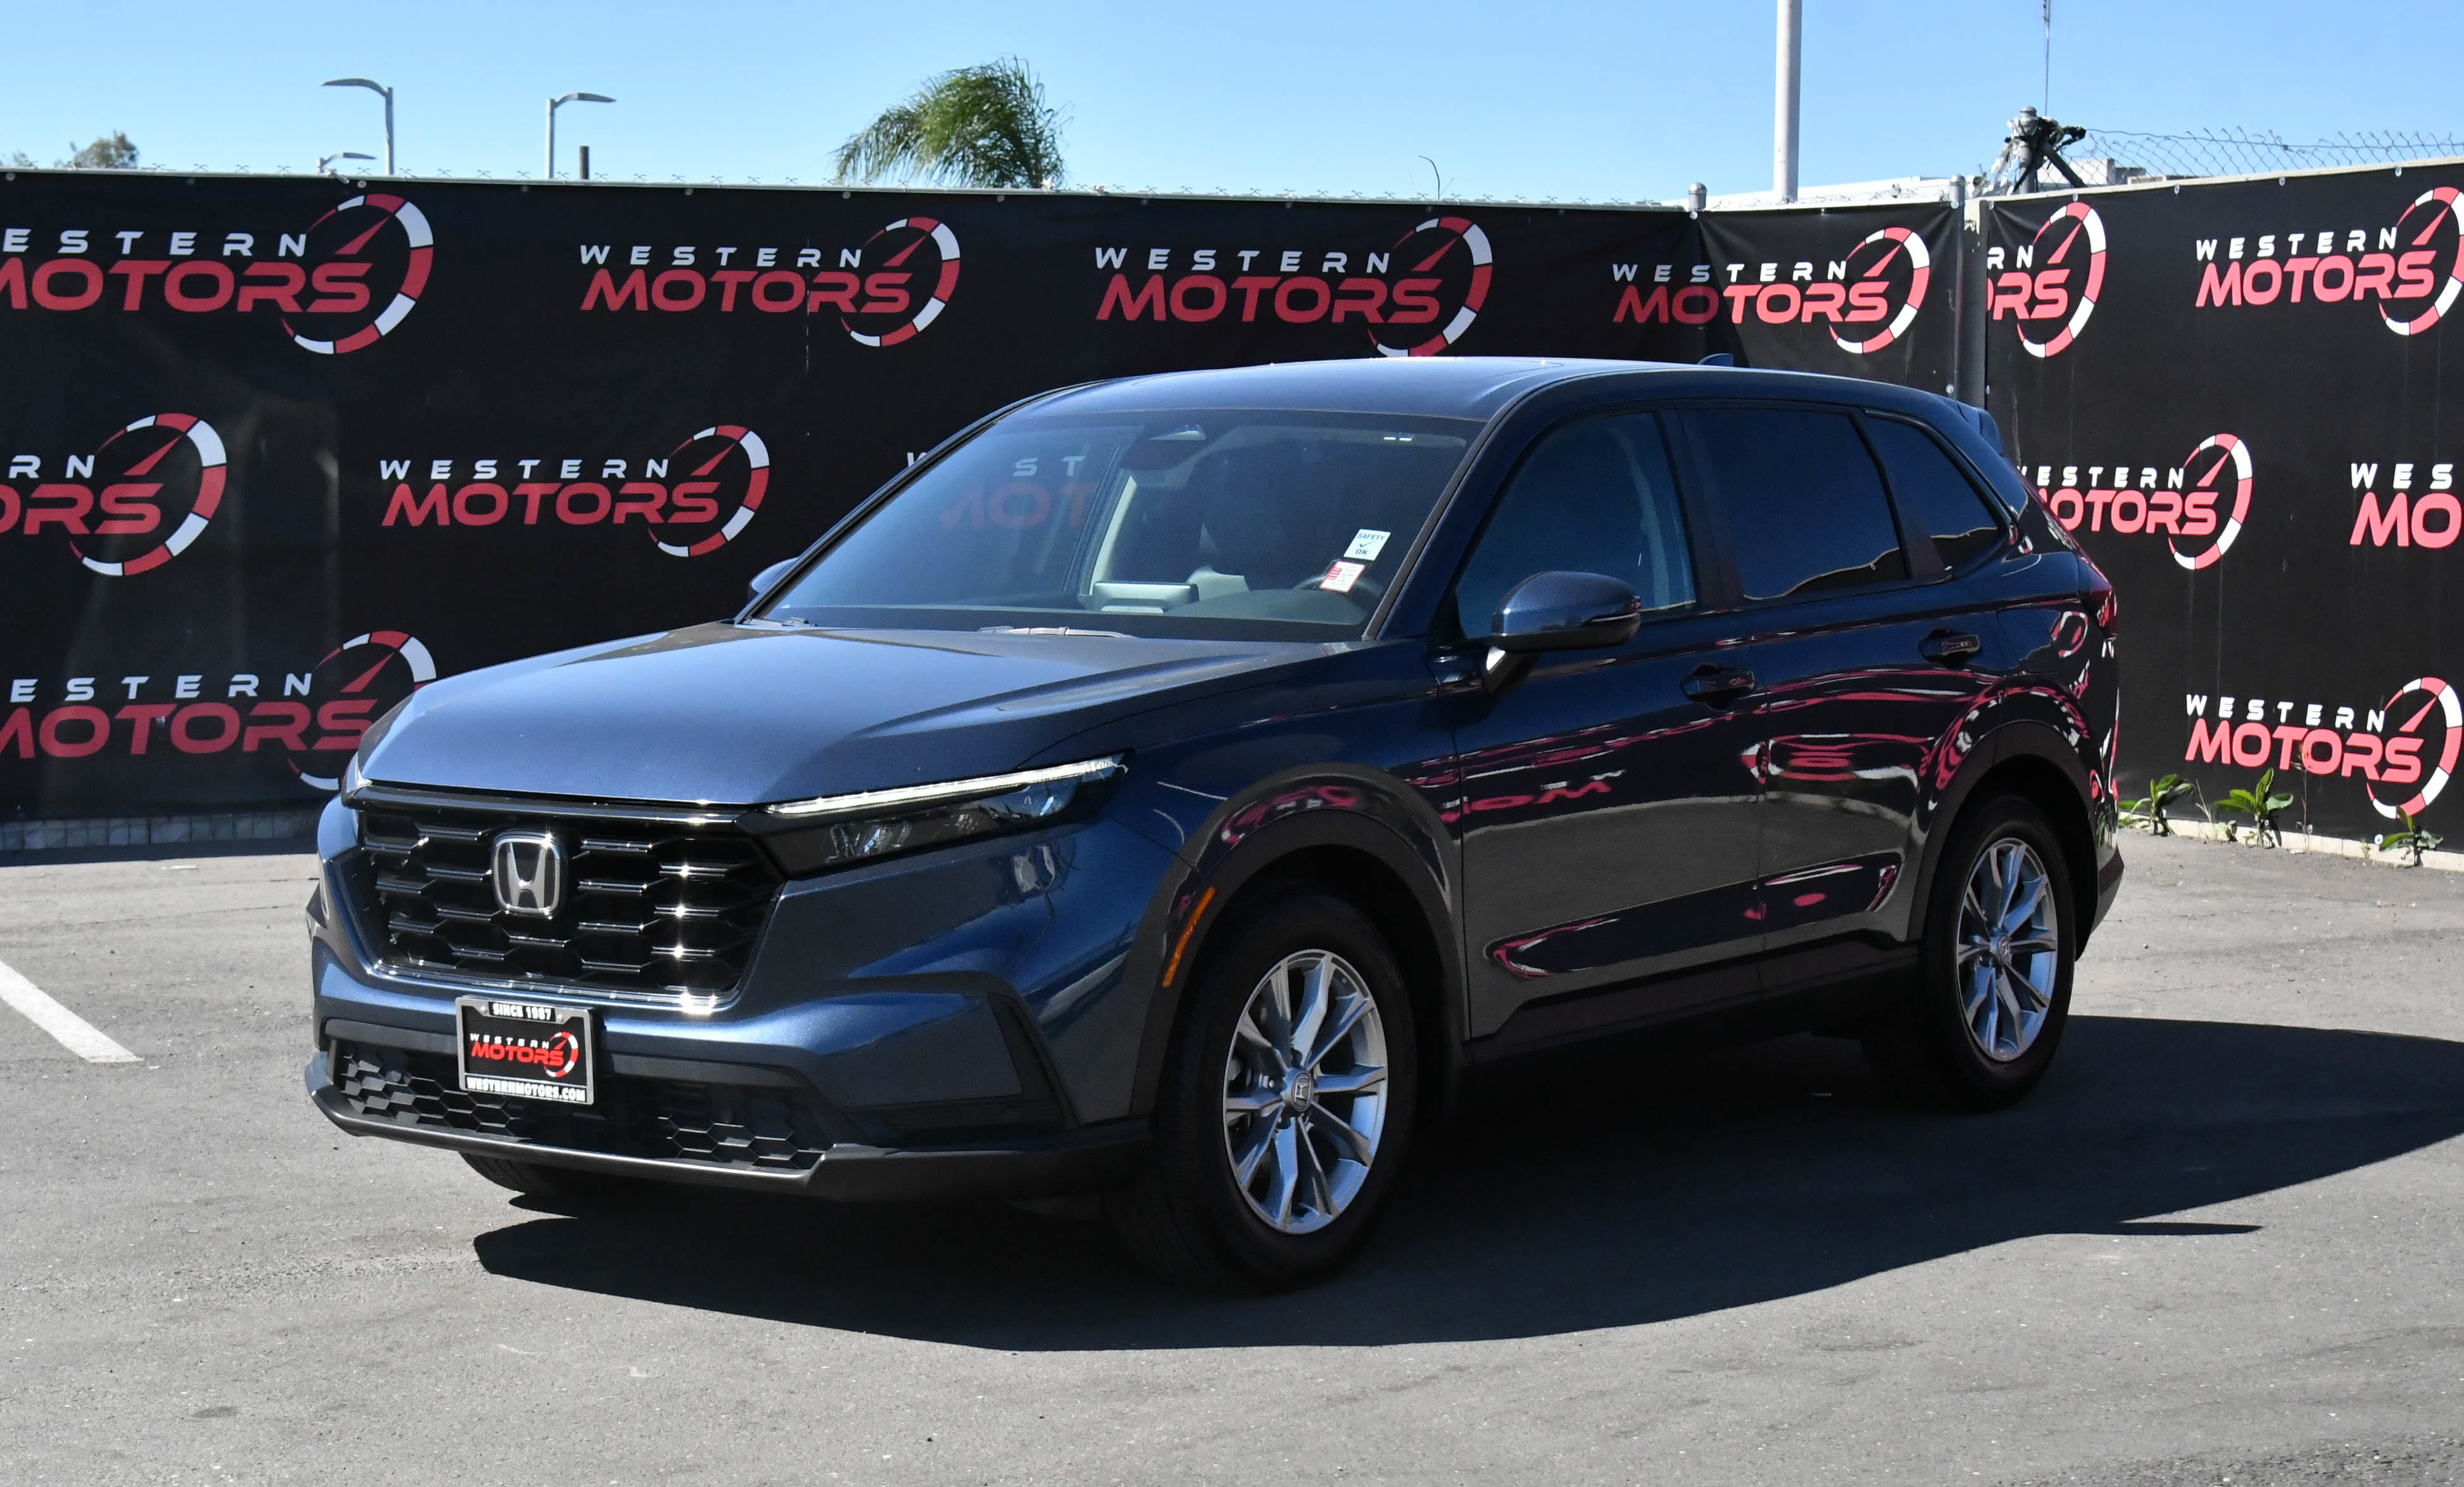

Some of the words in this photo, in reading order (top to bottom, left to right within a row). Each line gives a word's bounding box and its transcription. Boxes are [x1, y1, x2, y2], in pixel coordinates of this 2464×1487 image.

[580, 245, 862, 268] WESTERN
[1095, 248, 1390, 273] WESTERN
[2196, 227, 2397, 261] WESTERN
[1612, 260, 1847, 282] WESTERN
[2195, 250, 2437, 308] MOTORS
[581, 268, 913, 313] MOTORS
[1096, 273, 1442, 323] MOTORS
[1612, 281, 1890, 323] MOTORS
[380, 459, 669, 480] WESTERN
[381, 482, 721, 527] MOTORS
[2039, 487, 2219, 536] OTORS
[2186, 694, 2385, 732] WESTERN
[2185, 718, 2424, 784] MOTORS
[493, 1003, 524, 1017] SINCE
[470, 1032, 550, 1050] WESTERN
[471, 1041, 565, 1067] MOTORS
[467, 1077, 586, 1102] WESTERNMOTORS.COM
